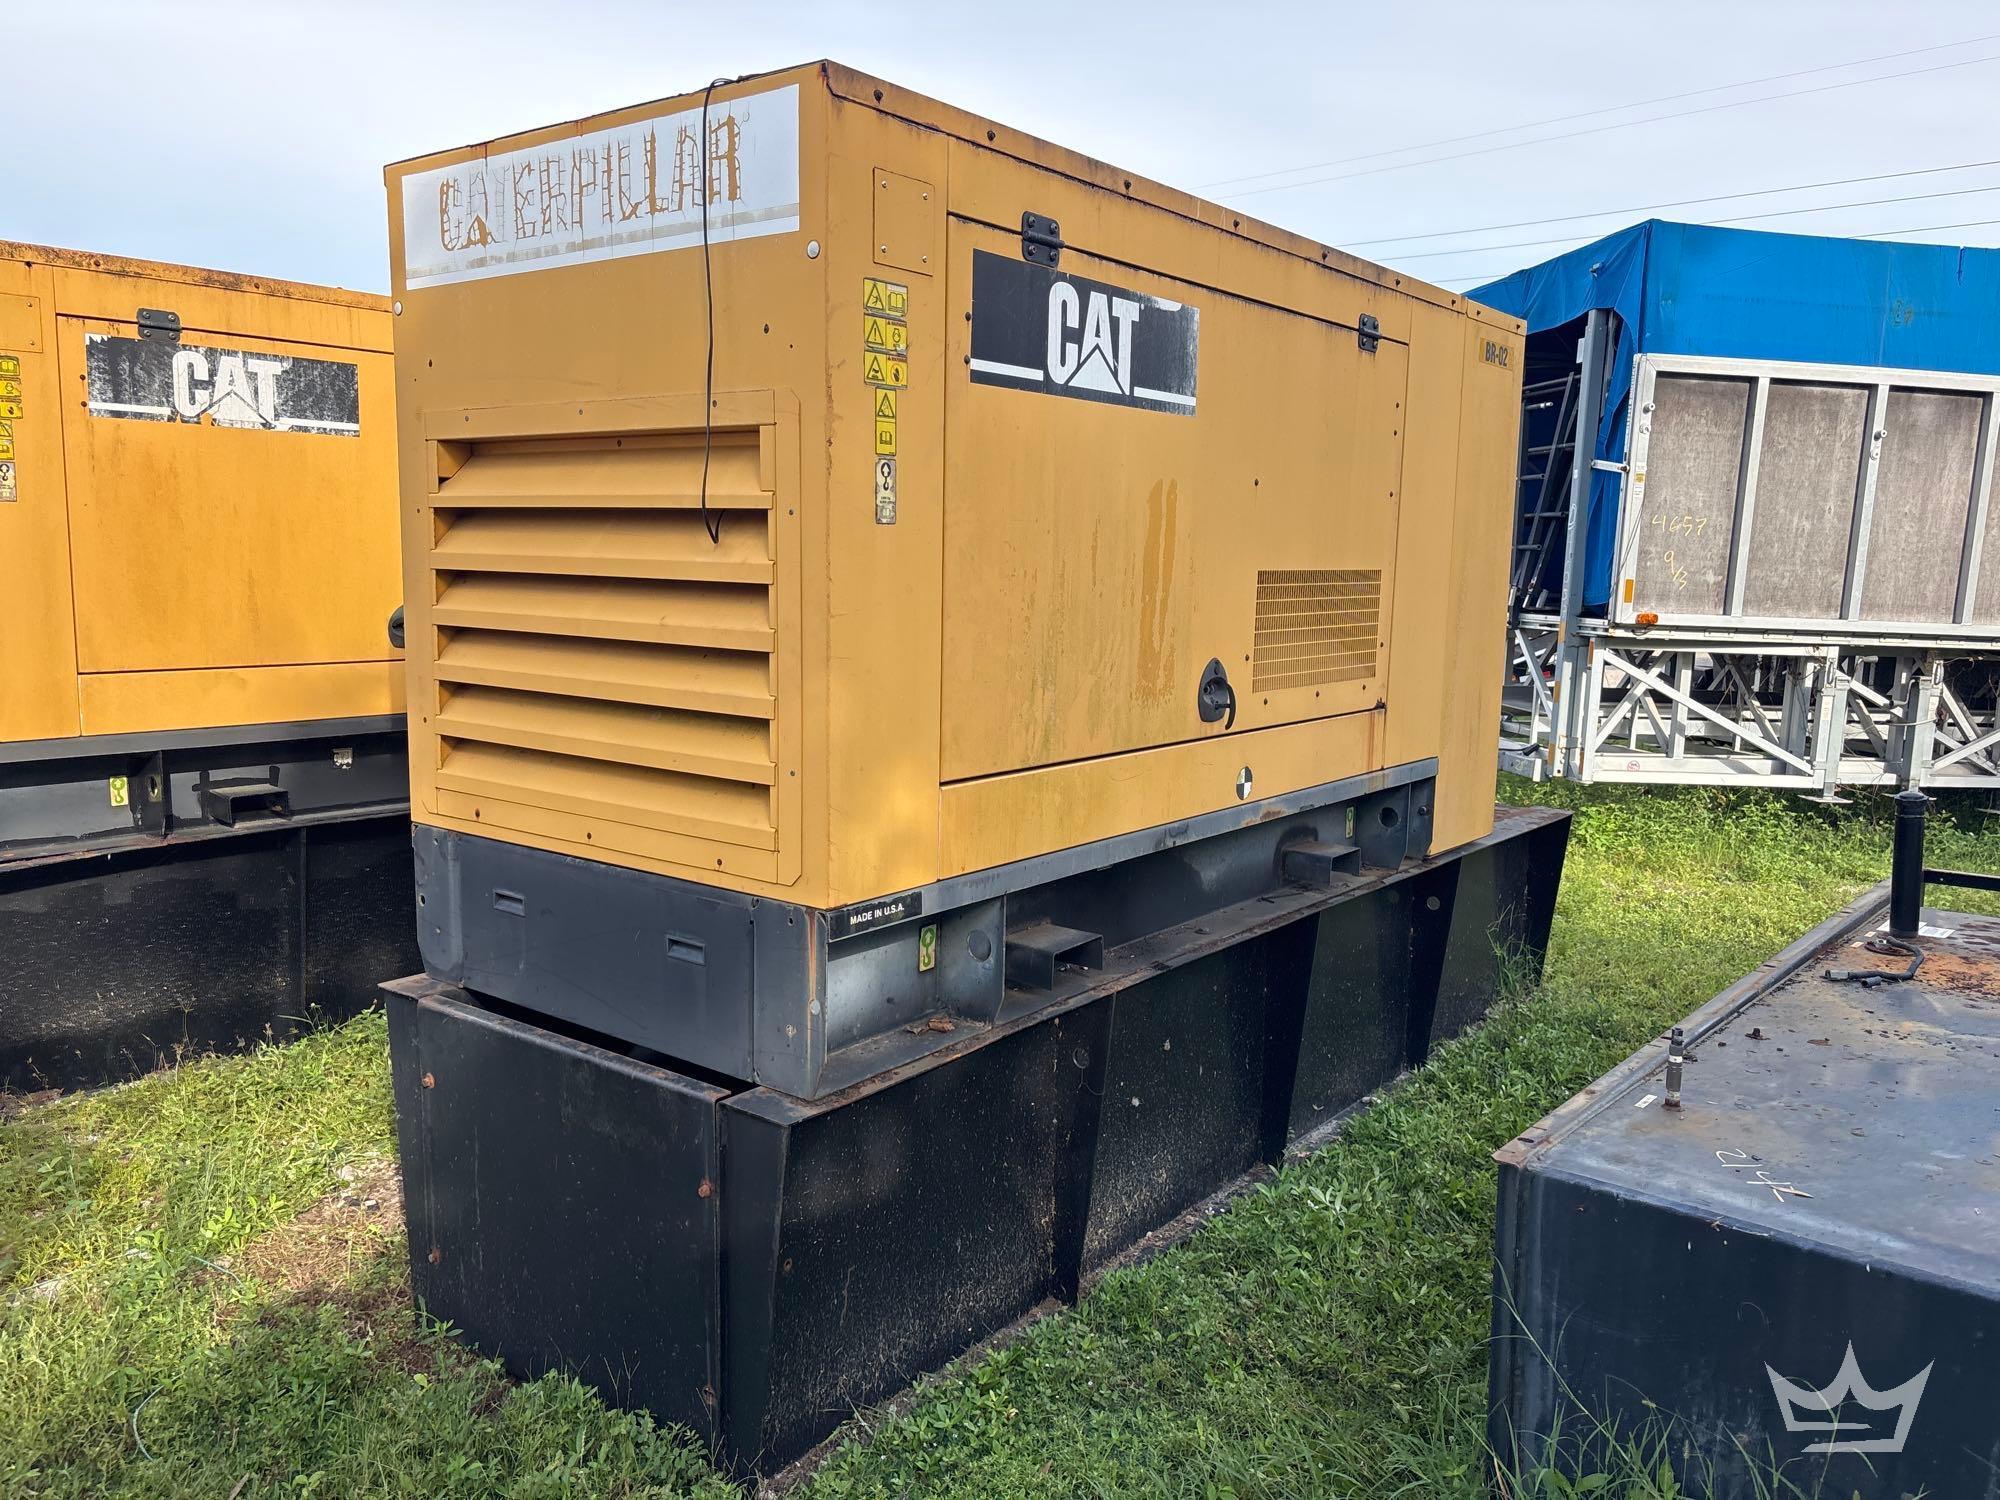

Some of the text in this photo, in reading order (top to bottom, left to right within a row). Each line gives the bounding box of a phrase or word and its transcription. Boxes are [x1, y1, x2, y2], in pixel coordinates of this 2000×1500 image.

[1047, 281, 1140, 396] CAT
[1485, 341, 1509, 367] BR-02
[172, 350, 282, 423] CAT
[1651, 514, 1707, 536] 4657
[850, 903, 905, 925] MADE IN U.S.A.
